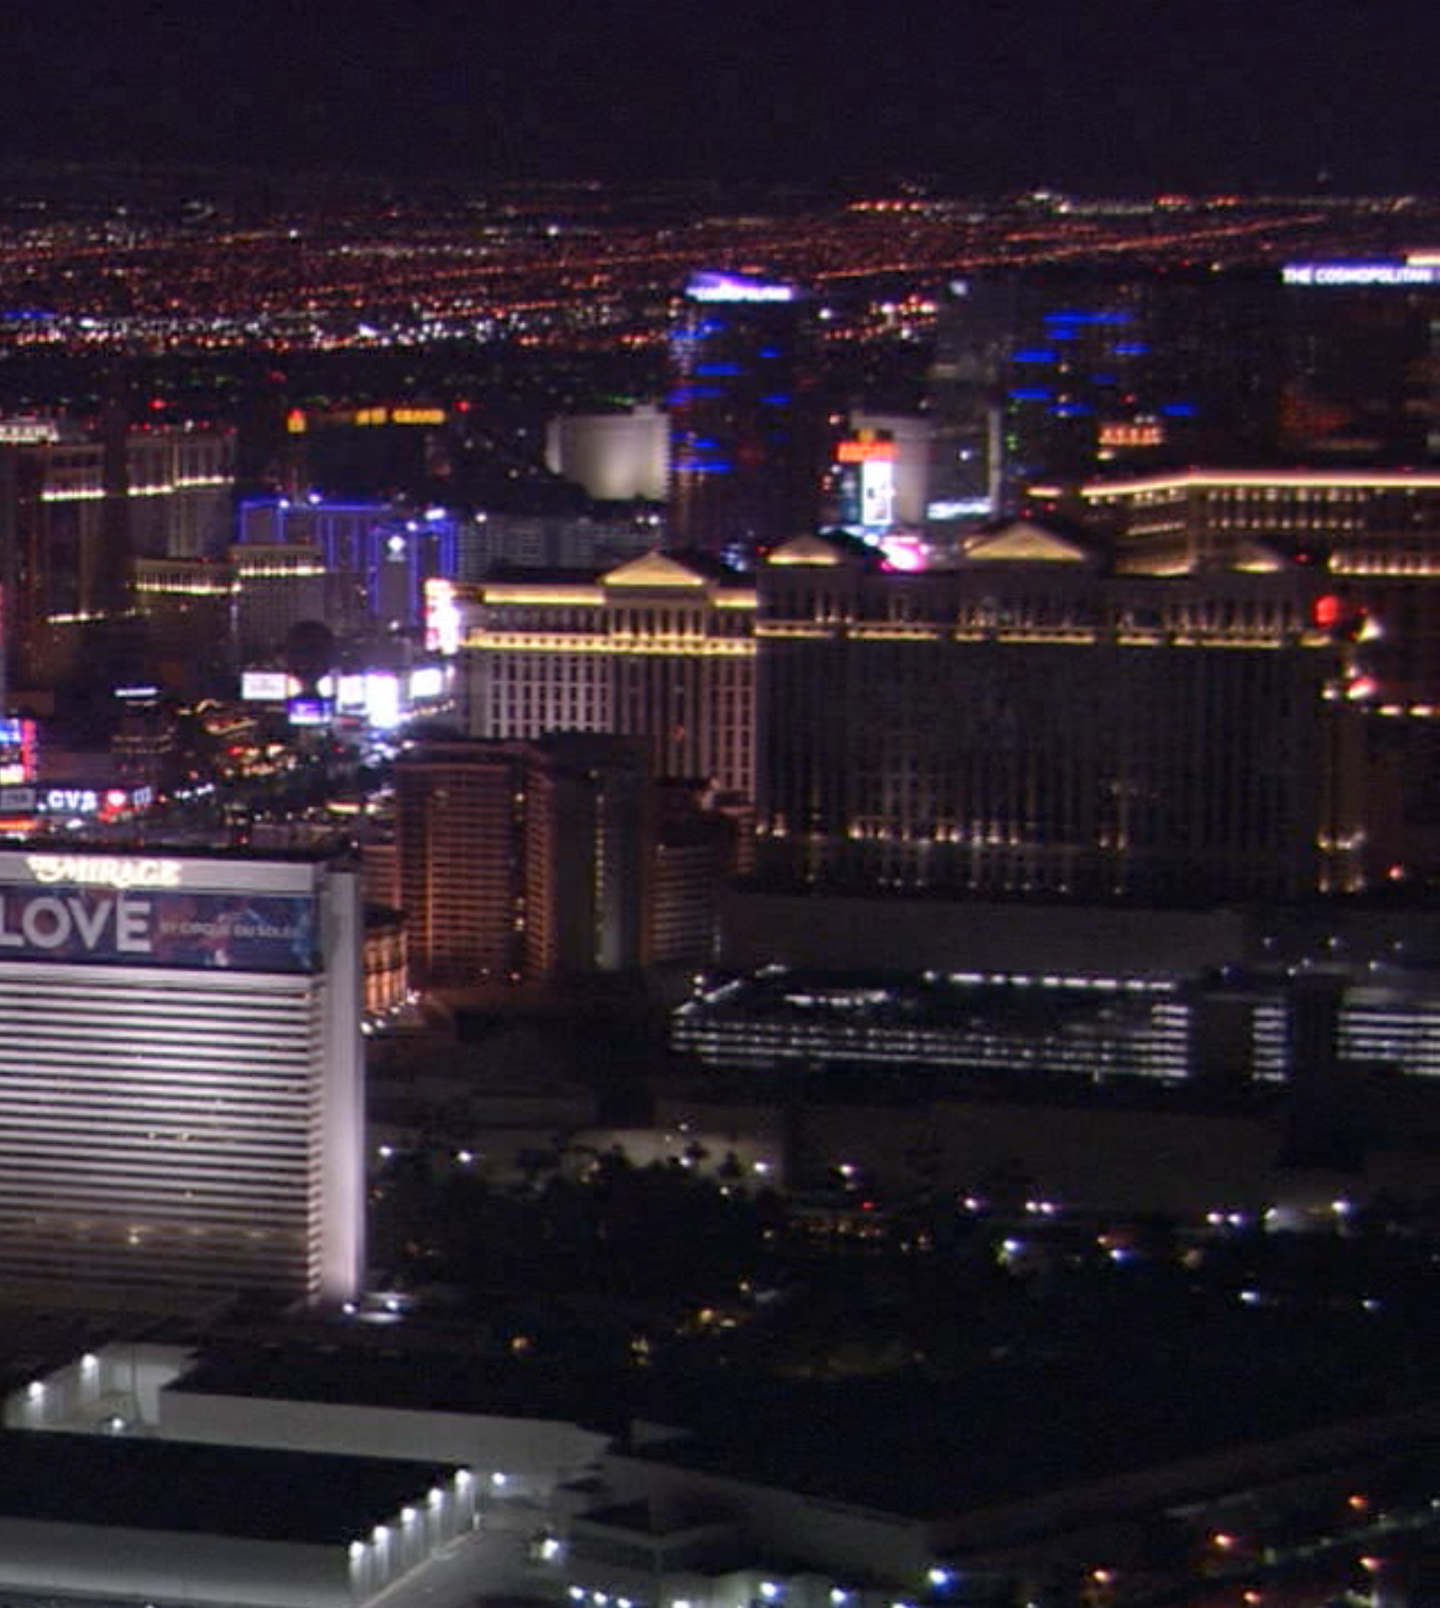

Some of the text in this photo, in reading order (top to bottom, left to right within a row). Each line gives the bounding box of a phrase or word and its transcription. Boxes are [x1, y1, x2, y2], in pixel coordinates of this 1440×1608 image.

[1282, 266, 1433, 285] THE COSMOPOLITAN
[47, 788, 98, 811] CVS
[36, 856, 182, 888] MIRAGE
